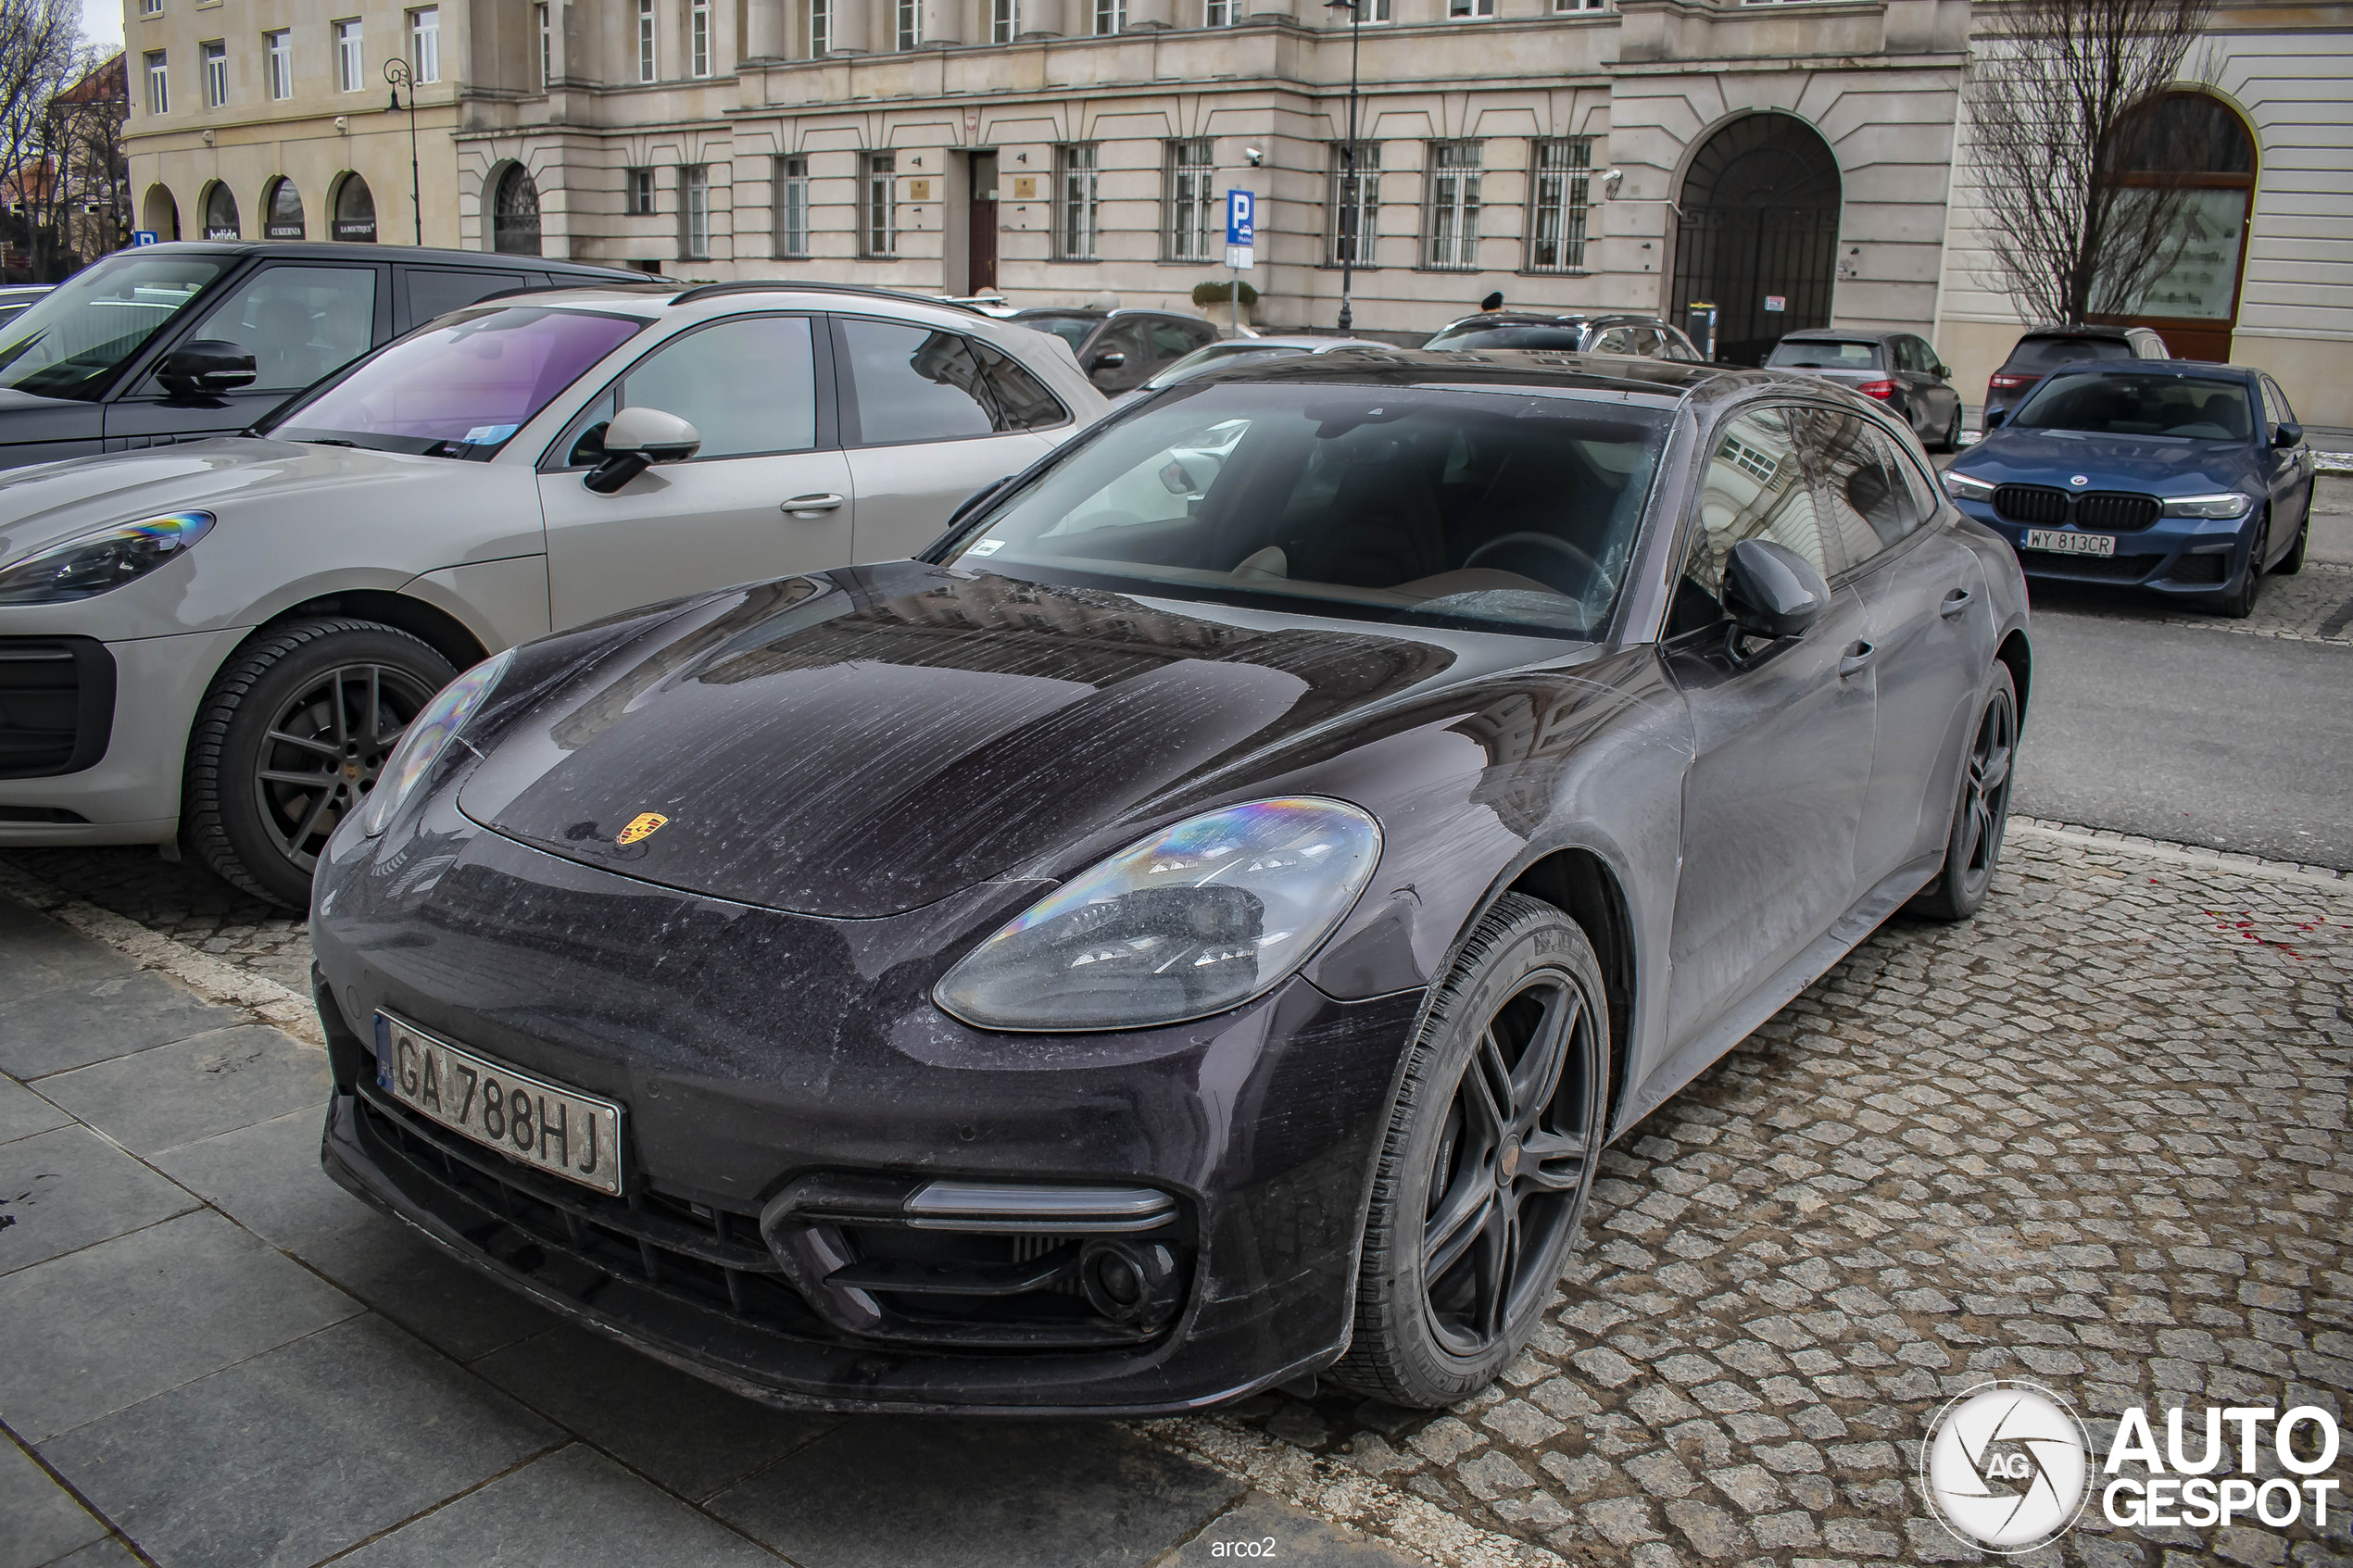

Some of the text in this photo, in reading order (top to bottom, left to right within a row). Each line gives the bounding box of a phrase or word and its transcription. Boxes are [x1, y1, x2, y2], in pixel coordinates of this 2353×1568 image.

[1233, 194, 1250, 230] P
[2032, 531, 2110, 554] WY 813CR
[397, 1036, 598, 1175] GA 788HJ
